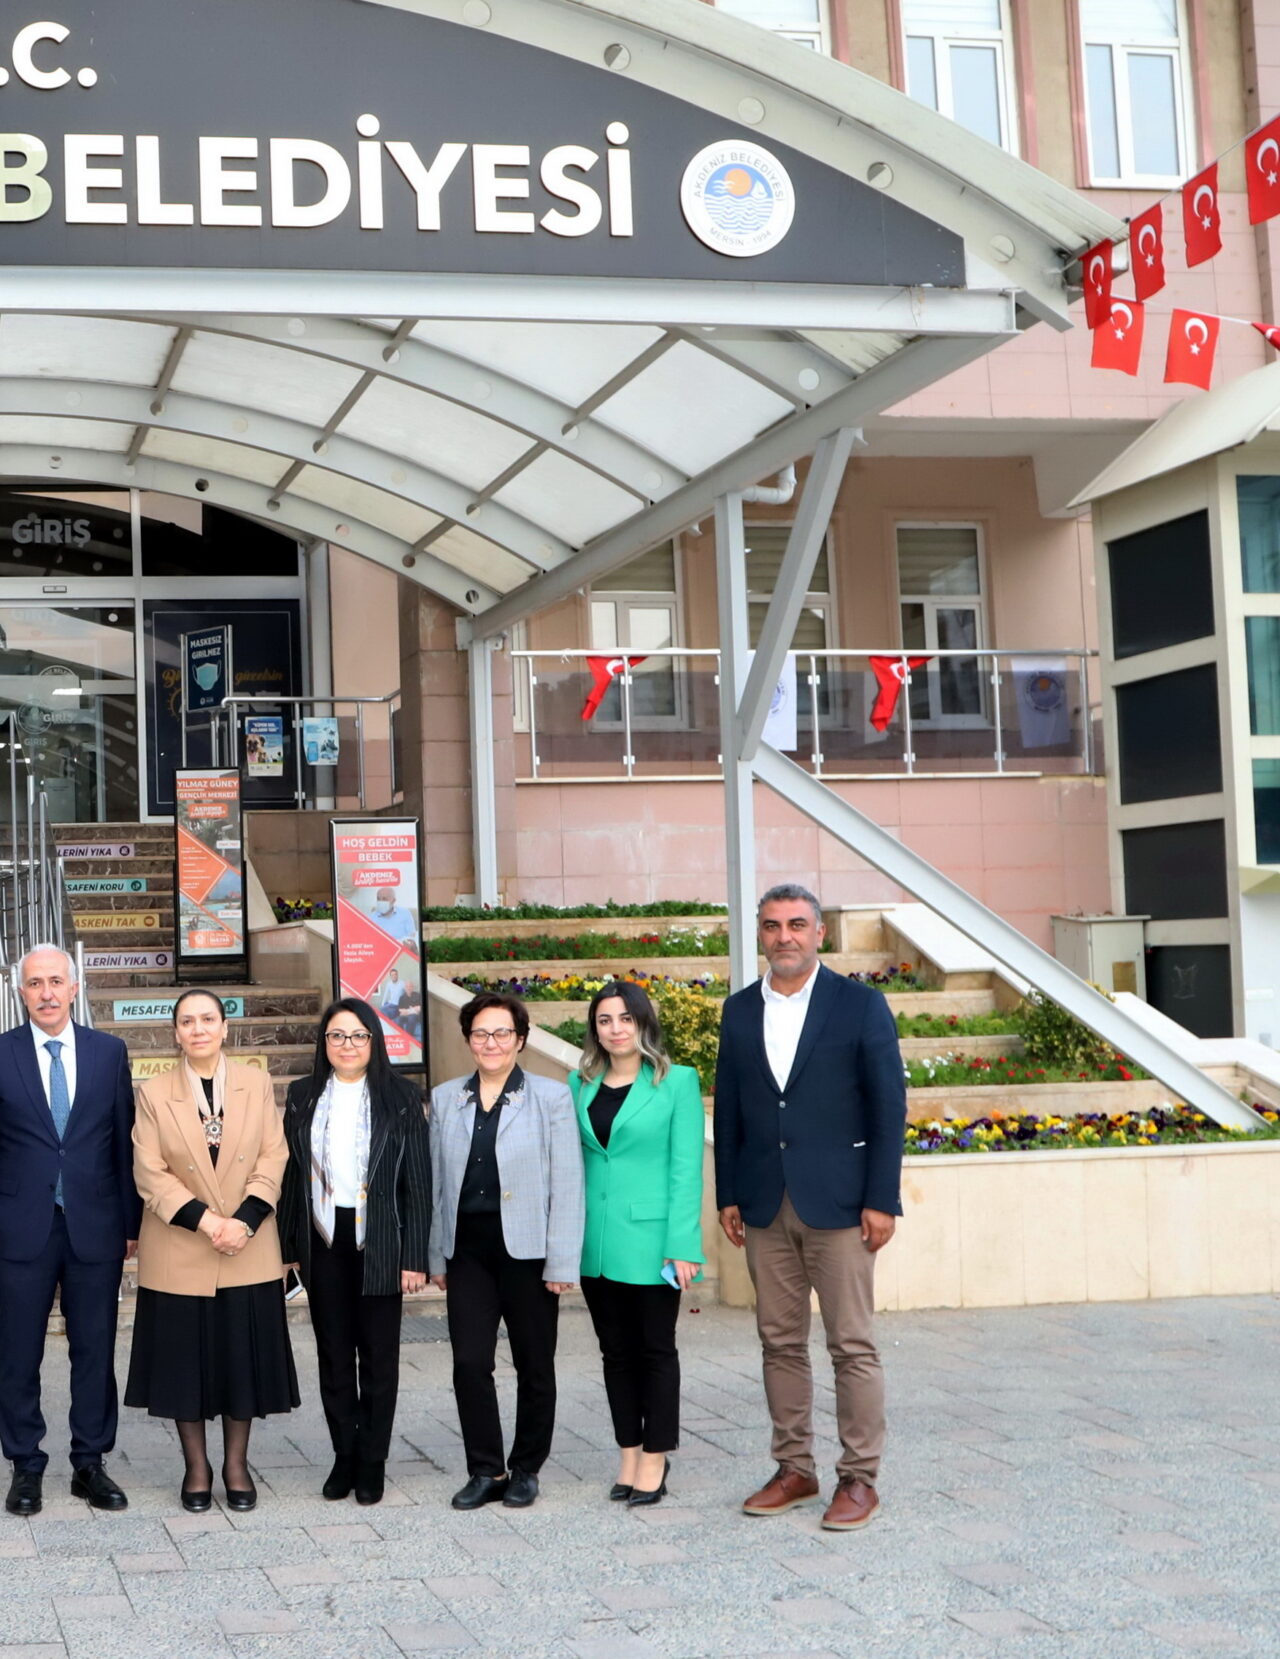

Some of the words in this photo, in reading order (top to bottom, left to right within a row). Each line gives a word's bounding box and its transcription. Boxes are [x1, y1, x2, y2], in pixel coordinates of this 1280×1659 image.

[693, 153, 727, 198] AKDENİZ
[730, 151, 786, 202] BELEDİYESİ
[11, 518, 91, 548] GİRİŞ
[190, 635, 222, 649] MASKESİZ
[191, 647, 221, 660] GİRİLMEZ
[210, 779, 238, 788] GÜNEY
[342, 838, 366, 849] HOŞ
[368, 836, 409, 847] GELDİN
[91, 847, 112, 856] YIKA
[358, 852, 393, 862] BEBEK
[100, 883, 124, 891] KORU
[74, 916, 114, 928] ASKENİ
[115, 918, 136, 927] TAK
[124, 956, 148, 966] YIKA
